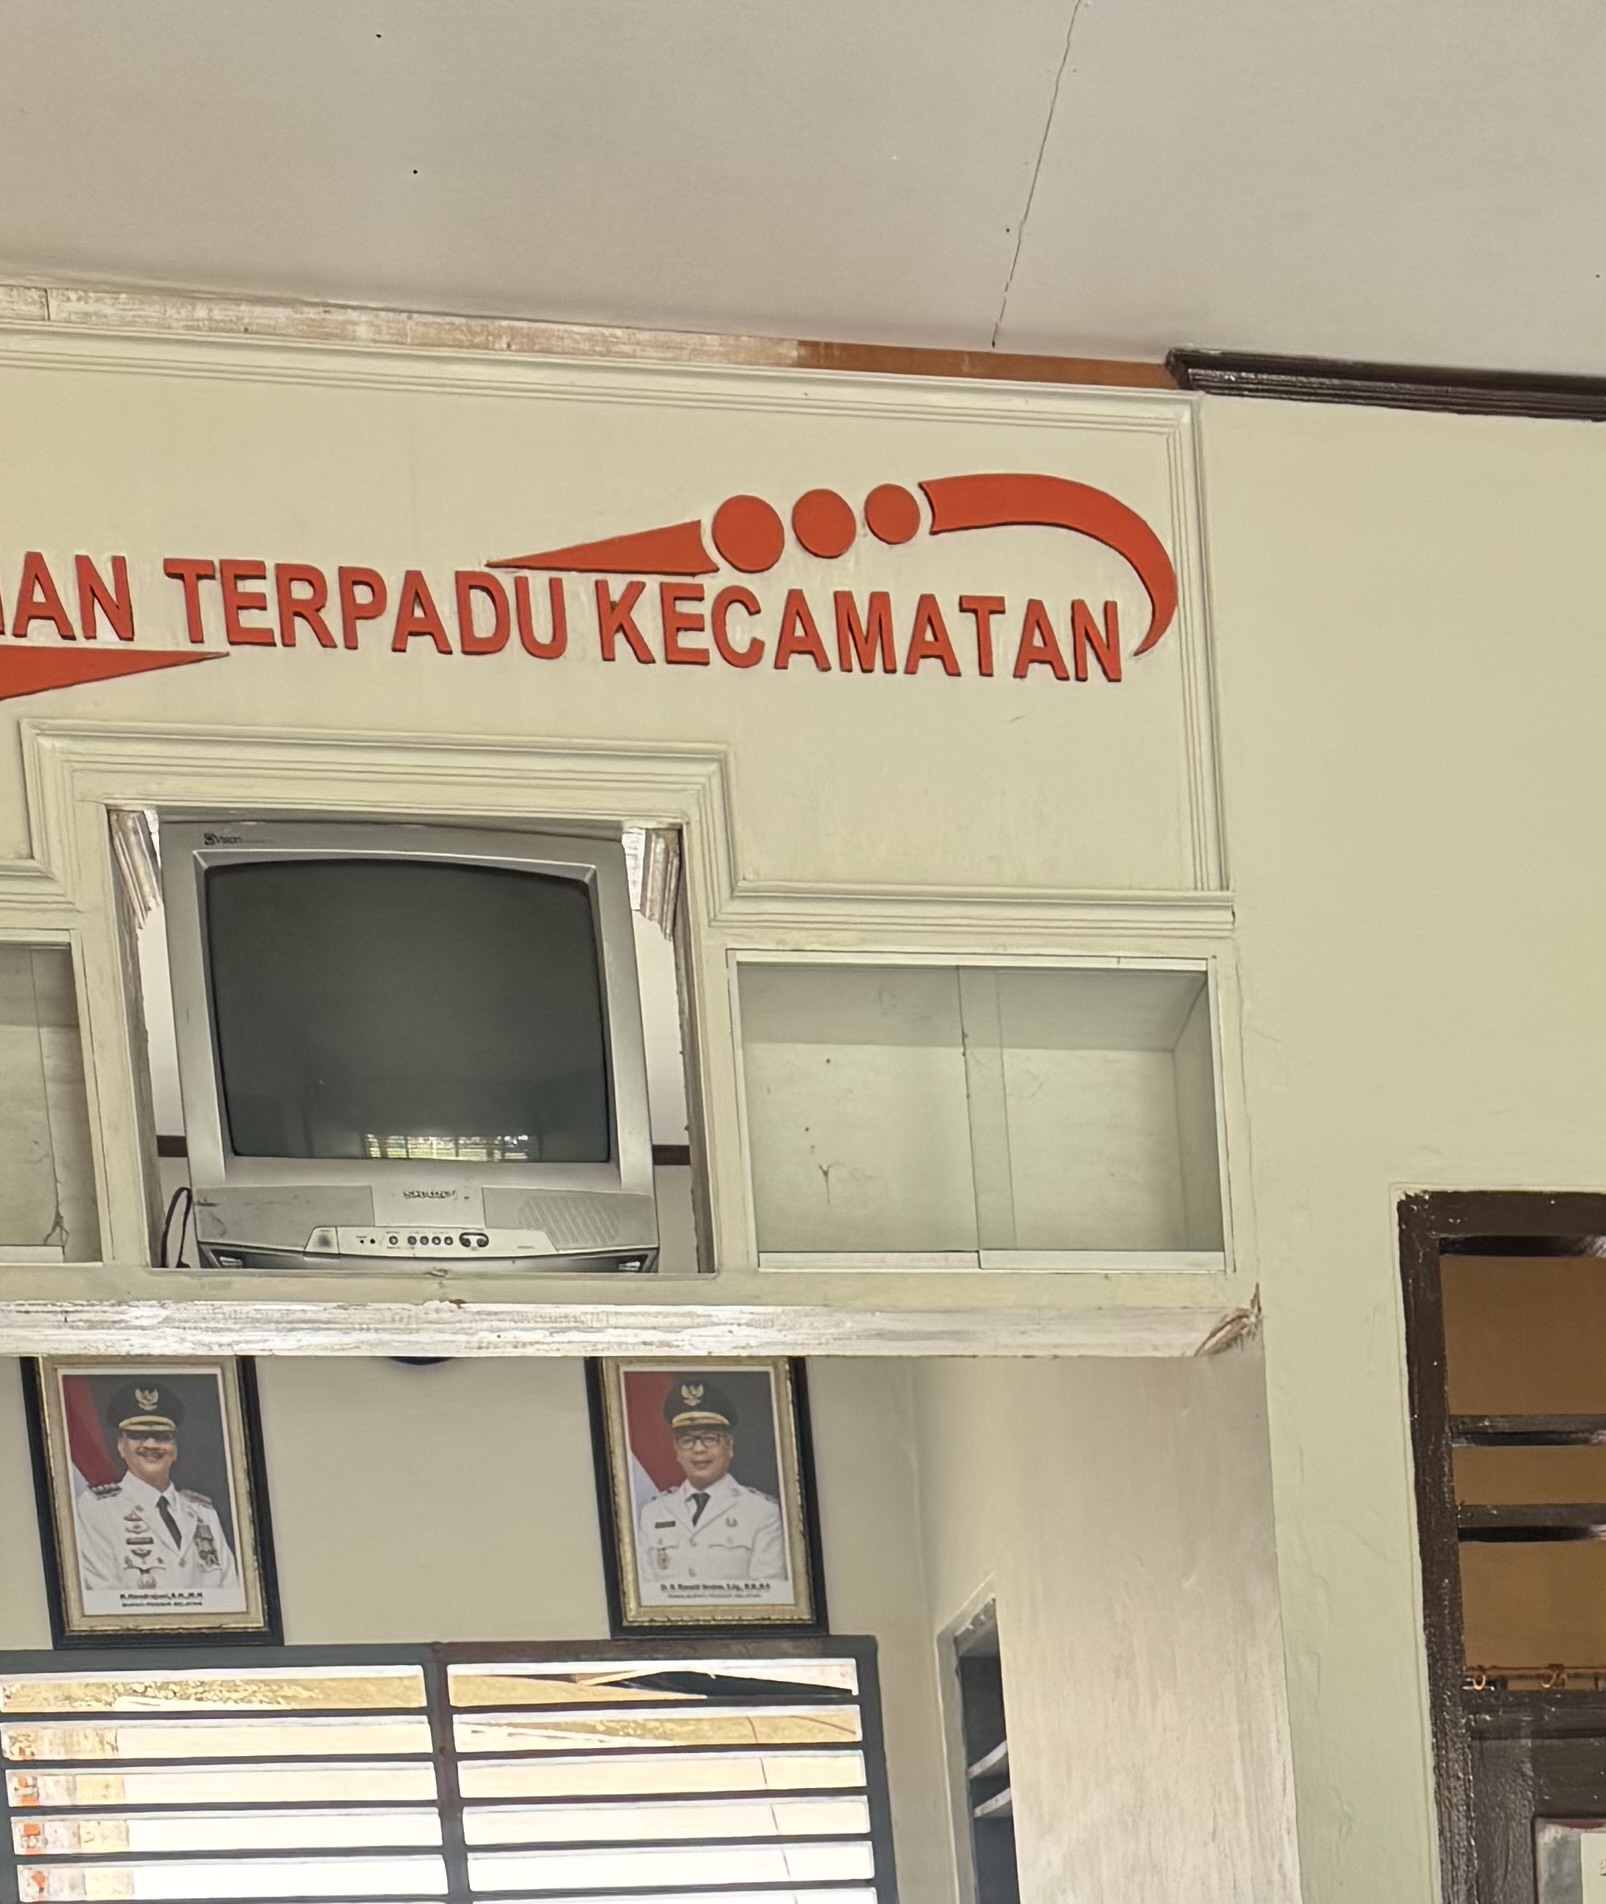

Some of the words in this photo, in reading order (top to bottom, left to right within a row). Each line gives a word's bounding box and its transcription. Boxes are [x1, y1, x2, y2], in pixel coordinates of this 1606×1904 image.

[0, 552, 134, 641] AN
[163, 558, 567, 660] TERPADU
[596, 580, 1122, 683] KECAMATAN
